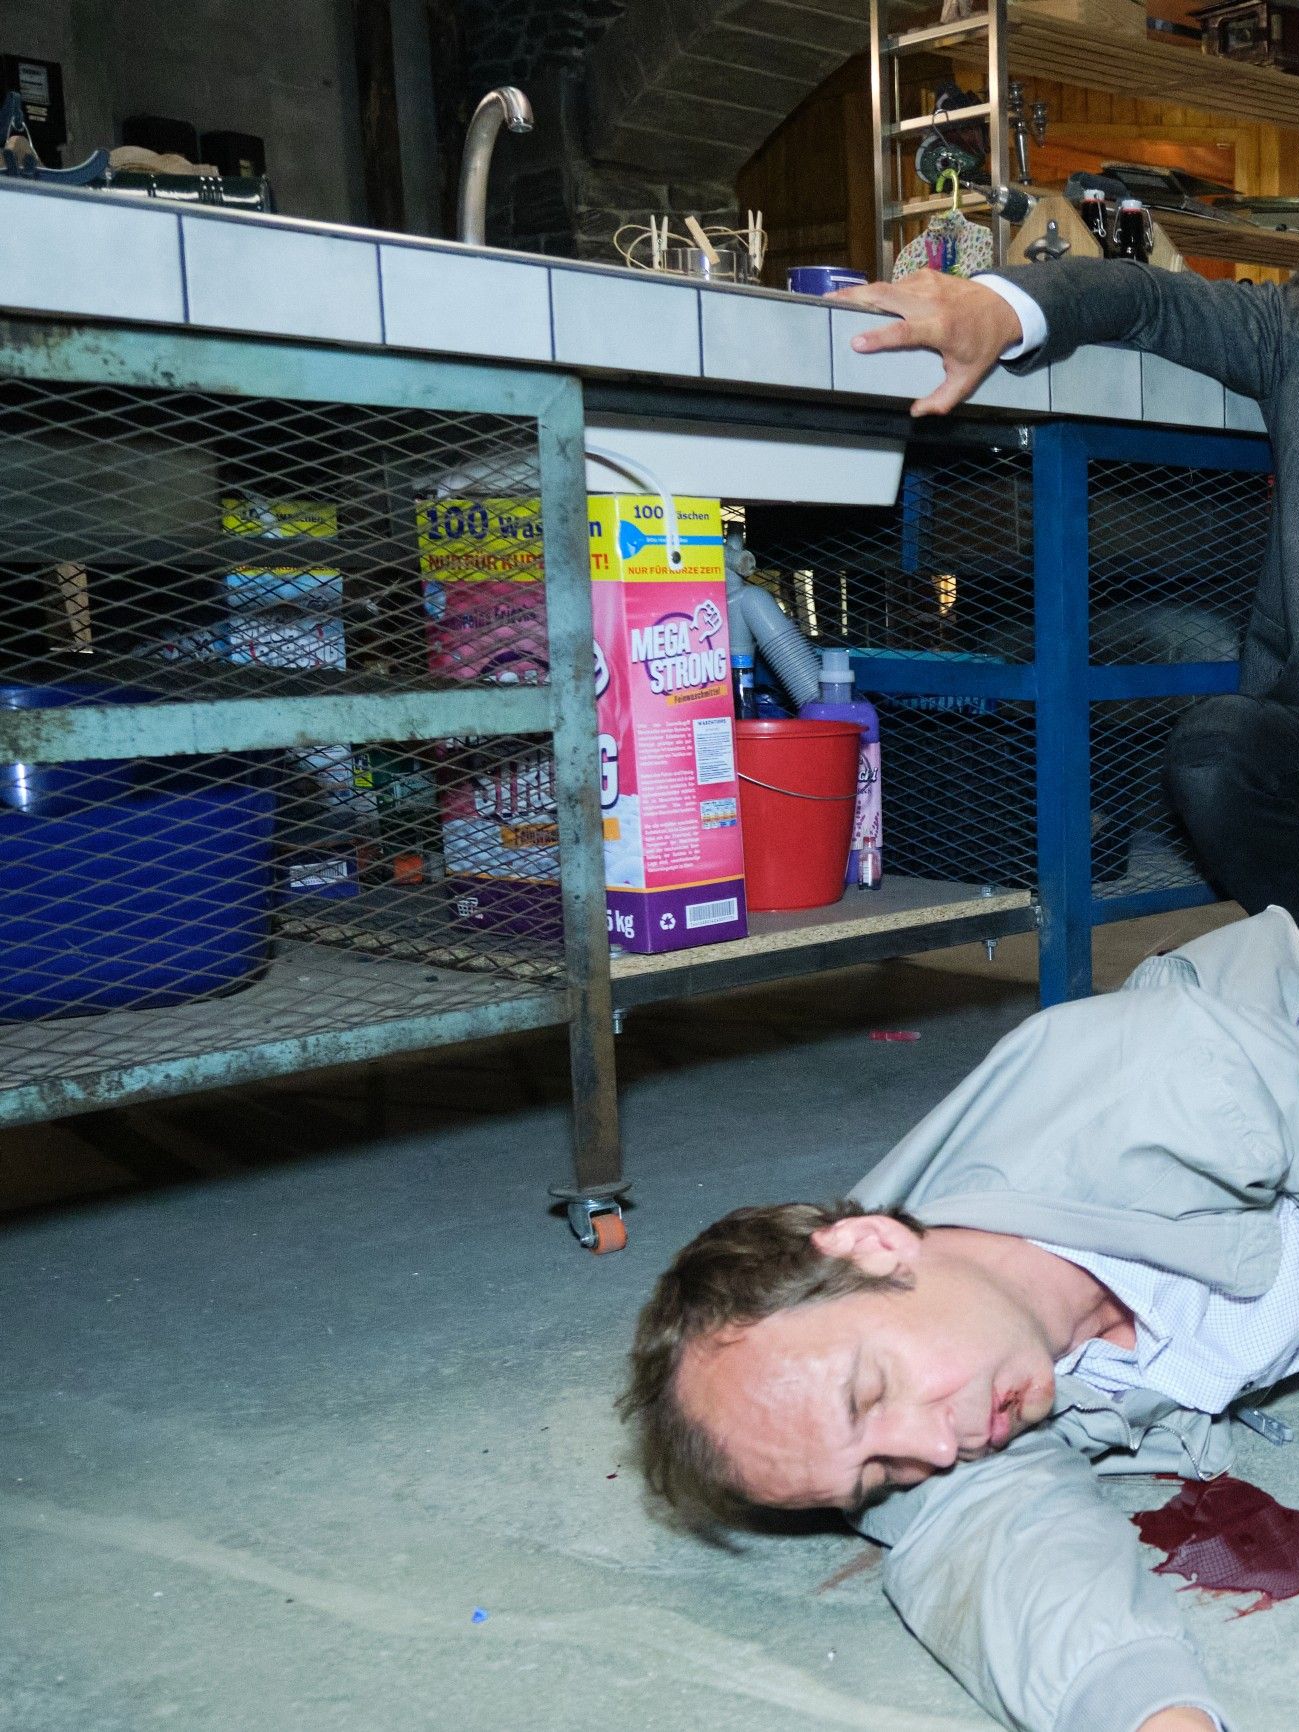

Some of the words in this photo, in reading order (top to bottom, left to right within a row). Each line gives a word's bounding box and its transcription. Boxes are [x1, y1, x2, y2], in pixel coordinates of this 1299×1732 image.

[426, 504, 489, 540] 100
[634, 505, 664, 520] 100
[676, 510, 709, 520] äschen
[628, 566, 648, 575] NUR
[650, 564, 669, 575] FÜR
[631, 620, 692, 665] MEGA
[650, 648, 727, 695] STRONG
[615, 909, 635, 939] kg
